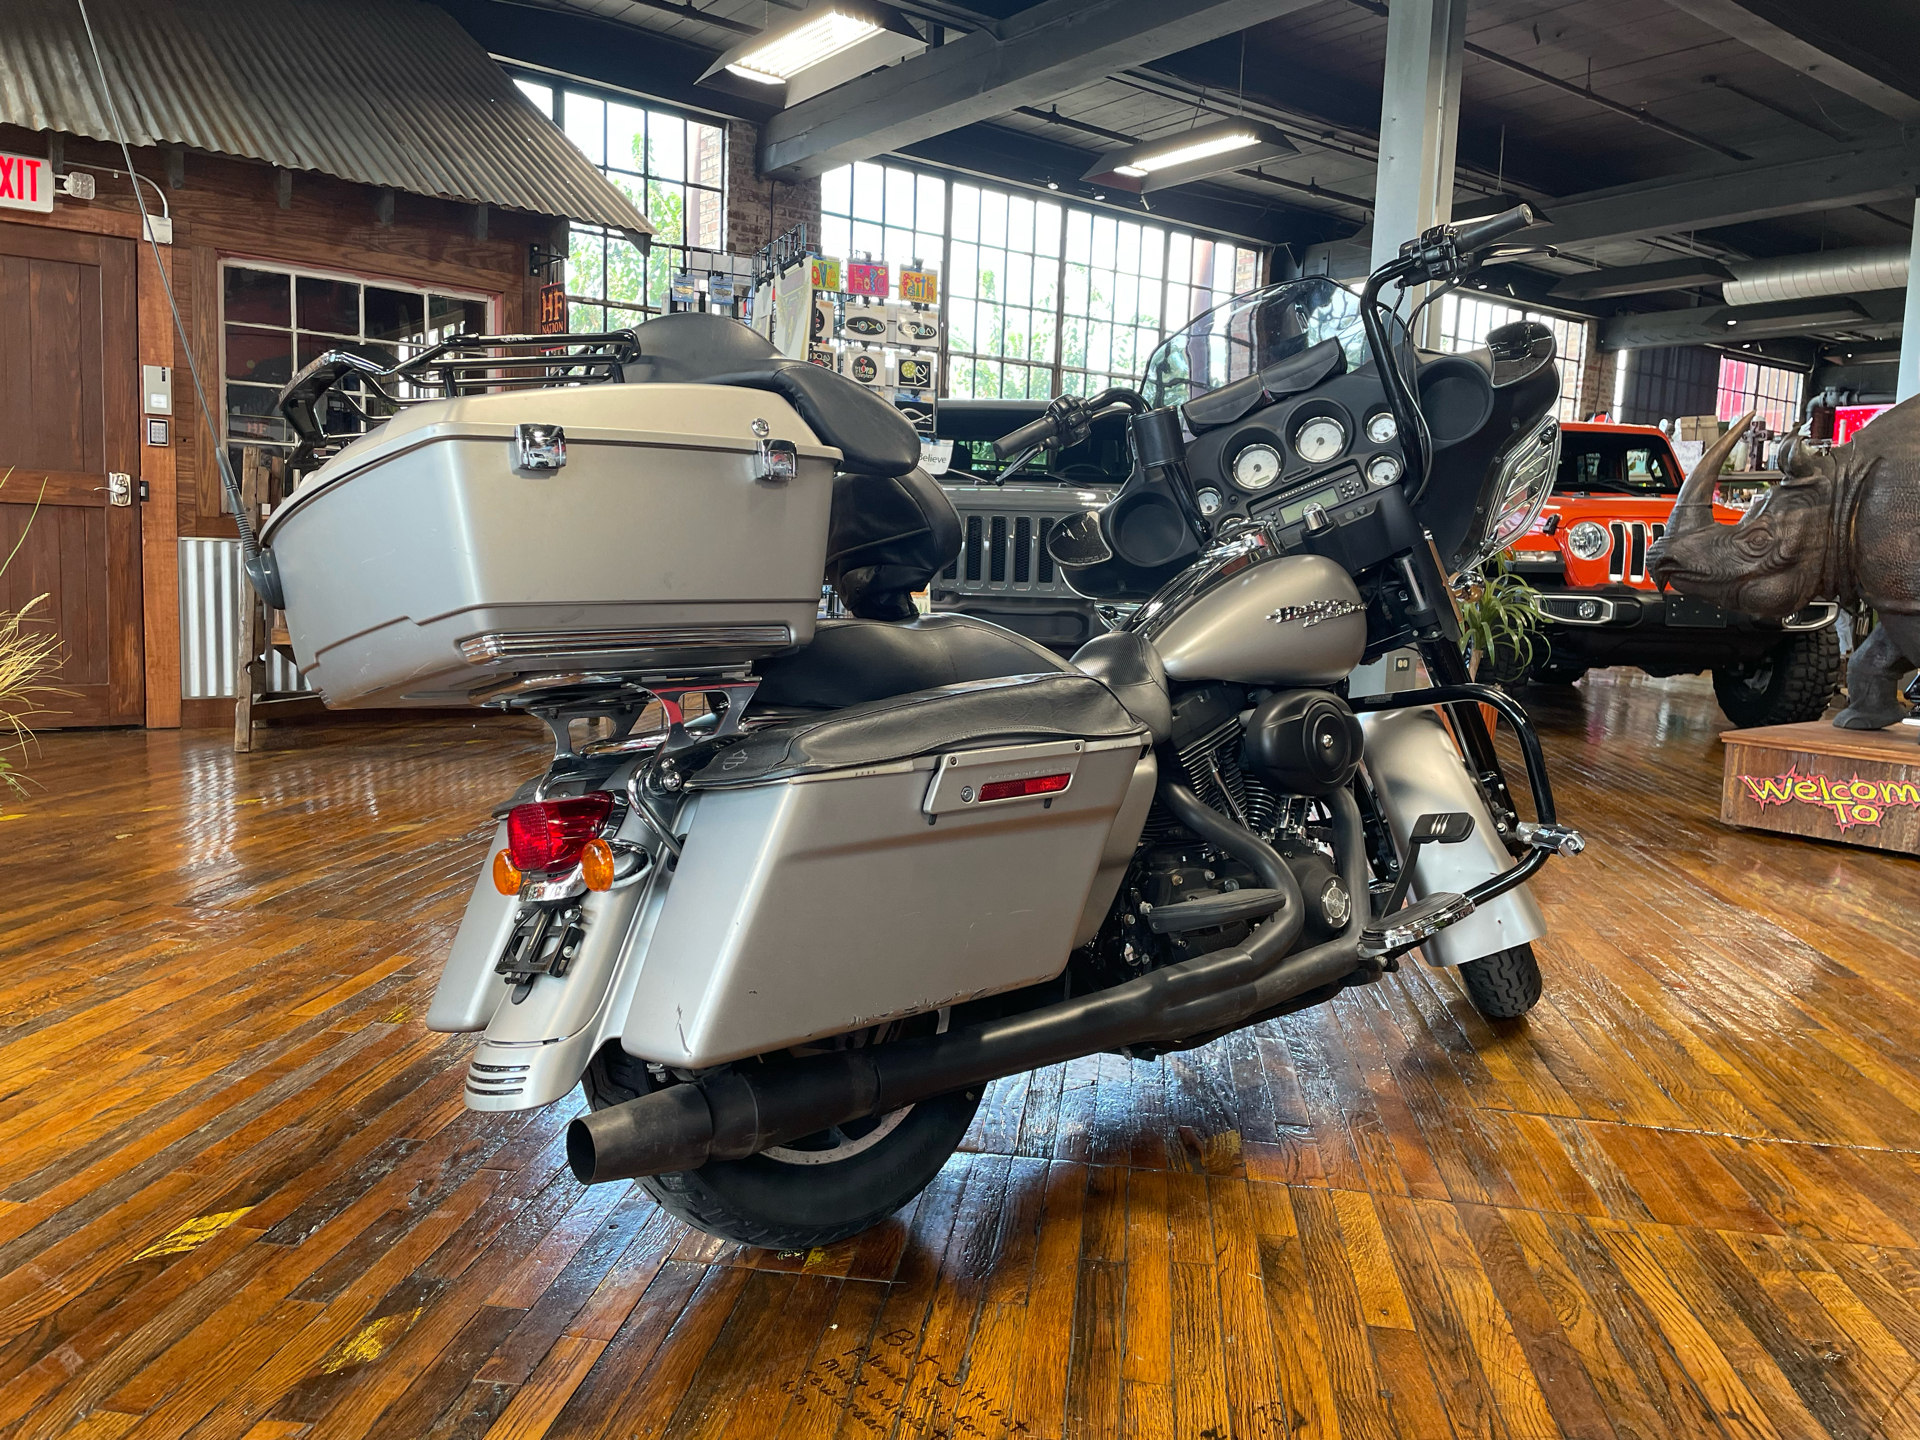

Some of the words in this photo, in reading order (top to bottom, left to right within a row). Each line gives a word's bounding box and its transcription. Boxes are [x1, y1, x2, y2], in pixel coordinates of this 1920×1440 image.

[0, 155, 41, 202] XIT
[542, 289, 563, 322] HF
[542, 322, 563, 334] NATION
[1746, 775, 1920, 803] Welcom
[1823, 800, 1879, 824] To
